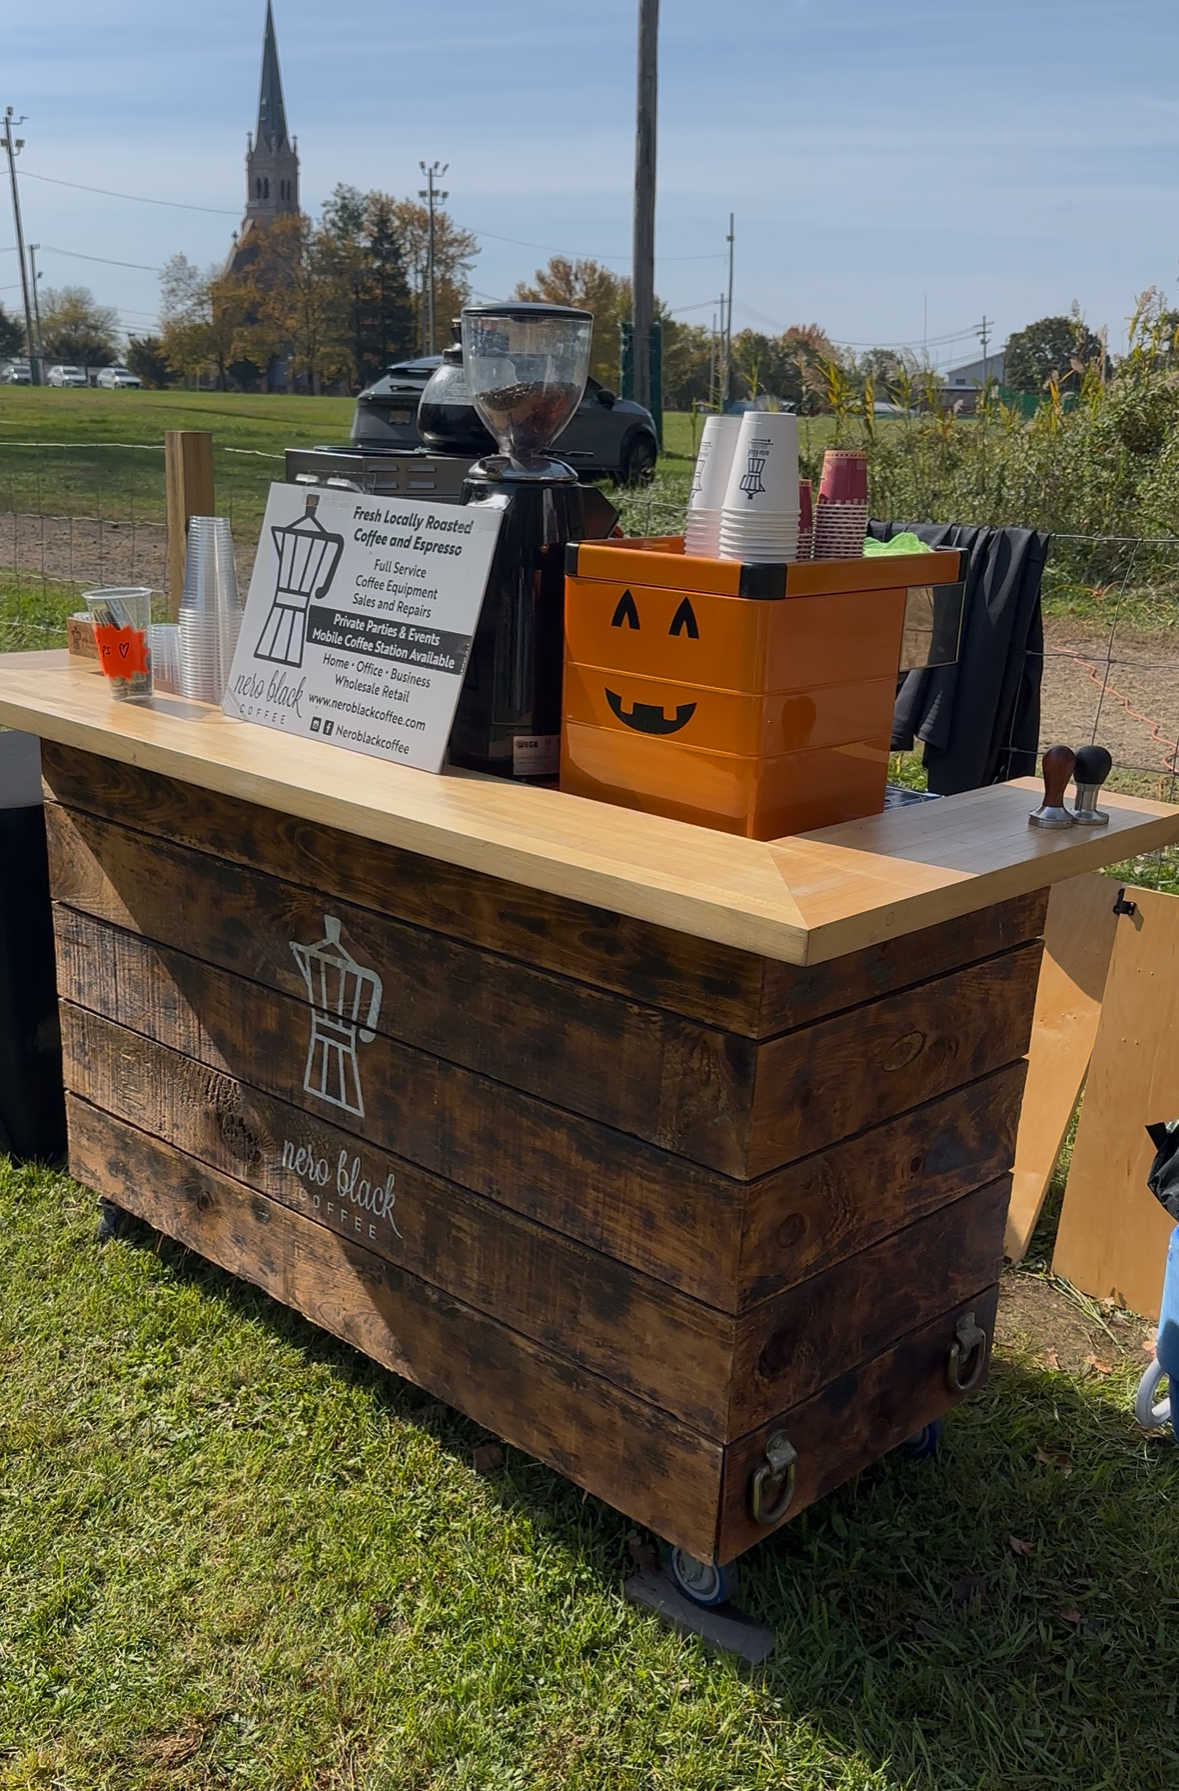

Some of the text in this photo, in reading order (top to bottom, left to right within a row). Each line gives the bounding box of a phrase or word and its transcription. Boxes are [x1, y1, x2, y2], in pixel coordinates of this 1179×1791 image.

[353, 506, 474, 534] Fresh Locally Roasted
[354, 528, 462, 556] Coffee and Espresso
[374, 559, 427, 578] Full Service
[355, 575, 438, 600] Coffee Equipment
[352, 593, 432, 618] Sales and Repairs
[333, 614, 440, 646] Private Parties & Events
[312, 628, 343, 645] Mobile
[344, 635, 374, 651] Coffee
[375, 641, 407, 659] Station
[409, 648, 455, 669] Available
[323, 653, 431, 688] Home Office Business
[234, 670, 307, 718] nero black
[335, 674, 410, 703] Wholesale Retail
[240, 703, 286, 725] COFFEE
[309, 693, 426, 731] www.neroblackcoffee.com
[336, 725, 410, 754] Neroblackcoffee
[282, 1140, 403, 1239] nero black
[300, 1188, 377, 1240] COFFEE
